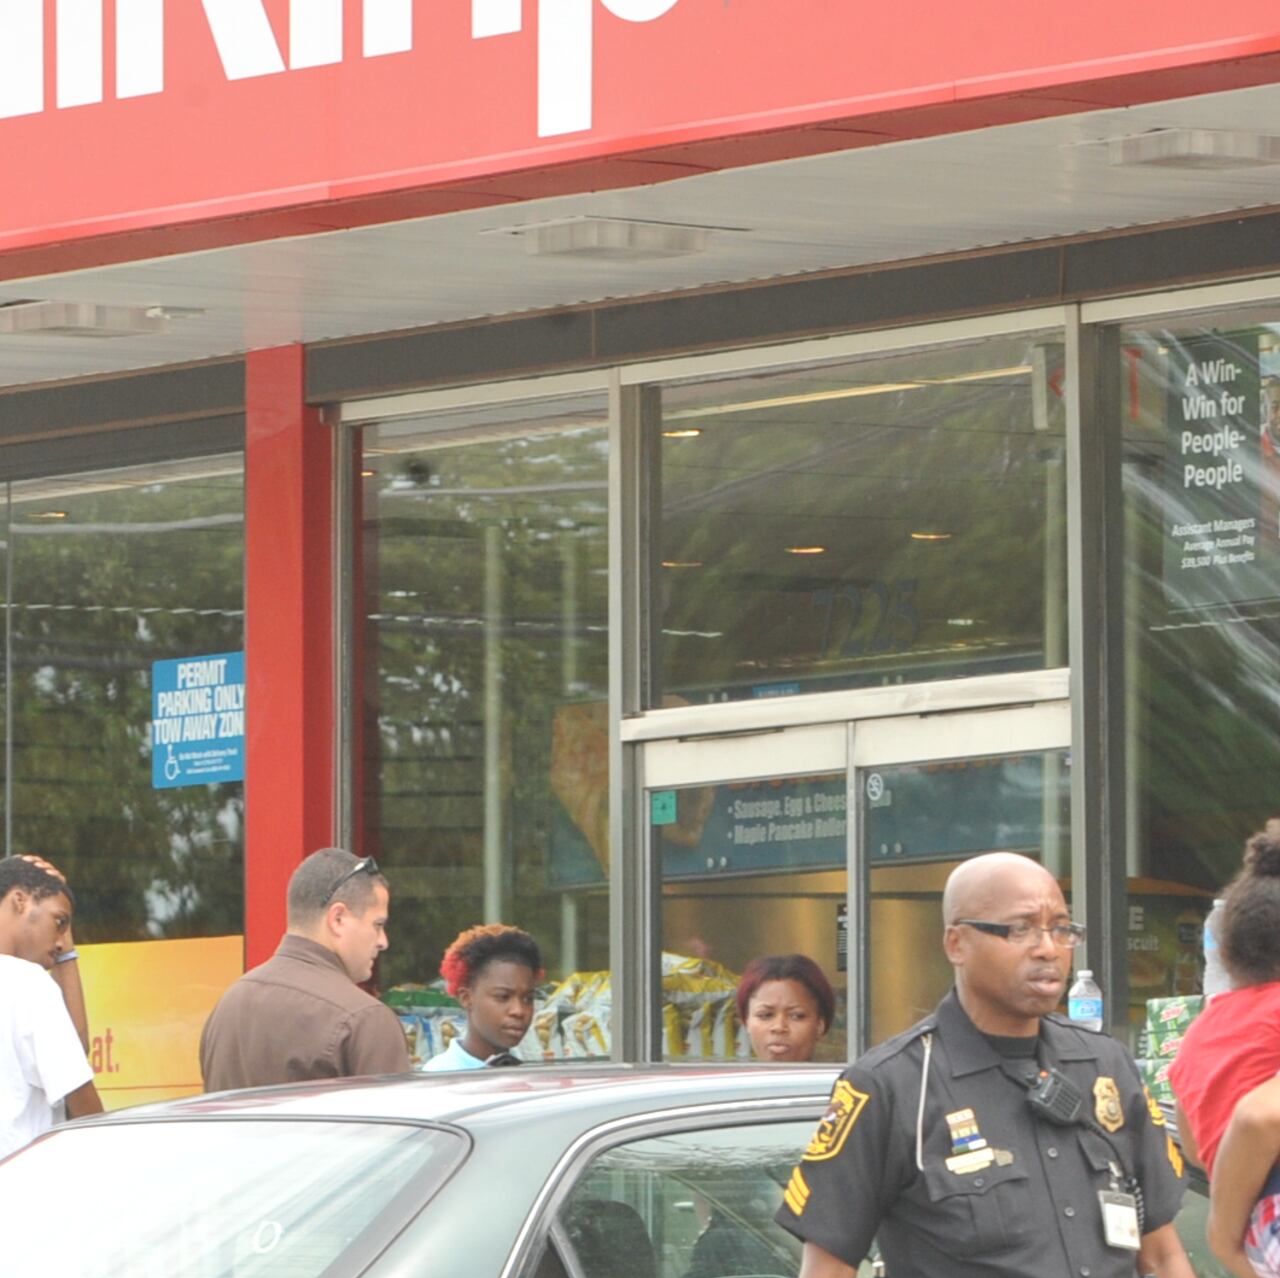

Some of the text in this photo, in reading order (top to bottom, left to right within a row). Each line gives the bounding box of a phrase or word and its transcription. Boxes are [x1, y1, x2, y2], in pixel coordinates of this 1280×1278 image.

[1185, 358, 1242, 387] A Win-
[1182, 391, 1245, 420] Win for
[1181, 425, 1246, 456] People-
[1183, 459, 1243, 489] People
[177, 659, 227, 689] PERMIT
[158, 687, 212, 717] PARKING
[153, 711, 245, 744] TOW AWAY ZON
